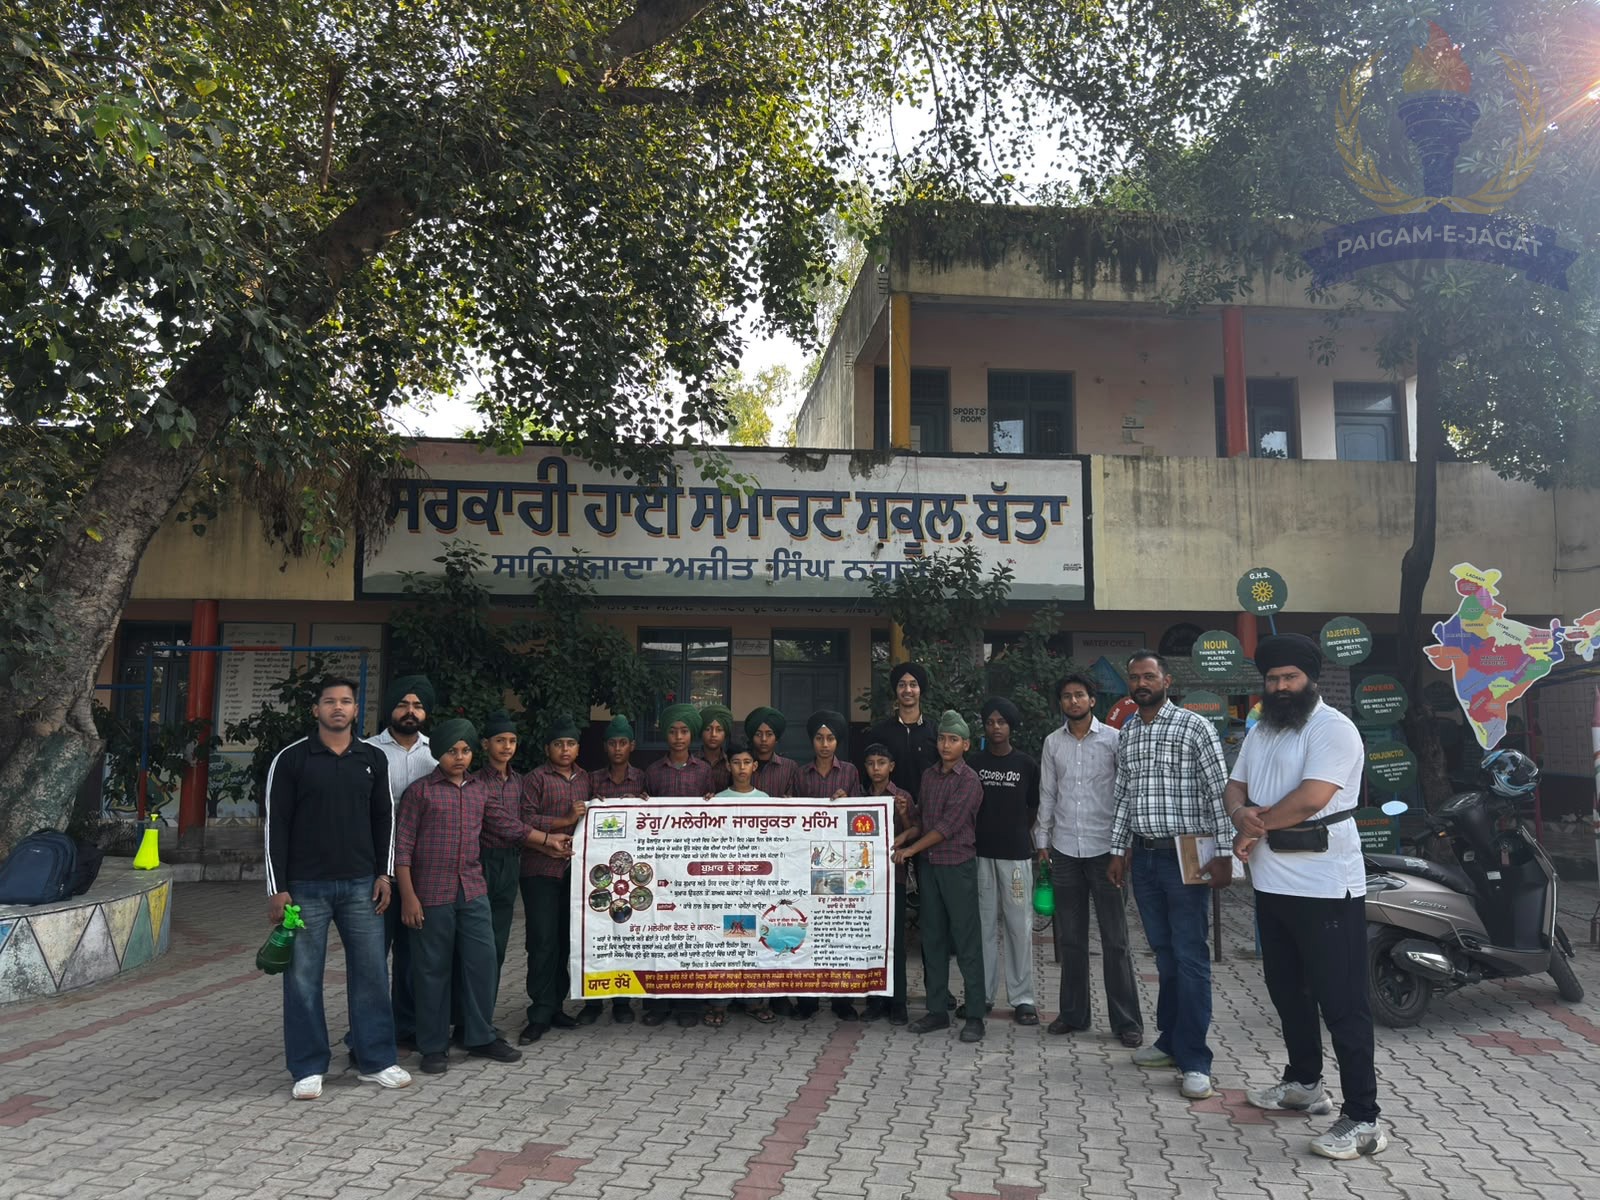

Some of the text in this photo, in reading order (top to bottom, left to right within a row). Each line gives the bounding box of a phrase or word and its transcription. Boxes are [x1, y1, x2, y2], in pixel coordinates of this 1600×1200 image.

[953, 408, 986, 416] SPORTS
[383, 456, 578, 536] ਸਰਕਾਰੀ
[689, 486, 851, 541] ਸਮਾਰਟ
[973, 482, 1068, 543] ਬੱਤਾ
[663, 546, 758, 582] ਅਜੀਤ
[766, 548, 835, 582] ਸਿੰਘ
[1249, 572, 1271, 580] G.H.S.
[1466, 572, 1486, 582] LADAKH
[1495, 622, 1509, 631] UTTAR
[1326, 627, 1361, 638] ADJECTIVES
[1502, 630, 1522, 643] PRADESH
[1082, 639, 1134, 647] WATER CYCLE
[1203, 640, 1228, 650] NOUN
[1362, 684, 1396, 693] ADVERB
[1184, 703, 1220, 711] PRONOUN
[732, 814, 796, 834] ਜਾਗਰੂਕਤਾ
[802, 811, 838, 832] ਮੁਹਿੰਮ
[727, 862, 734, 871] ਦੇ
[588, 979, 611, 990] ਯਾਦ
